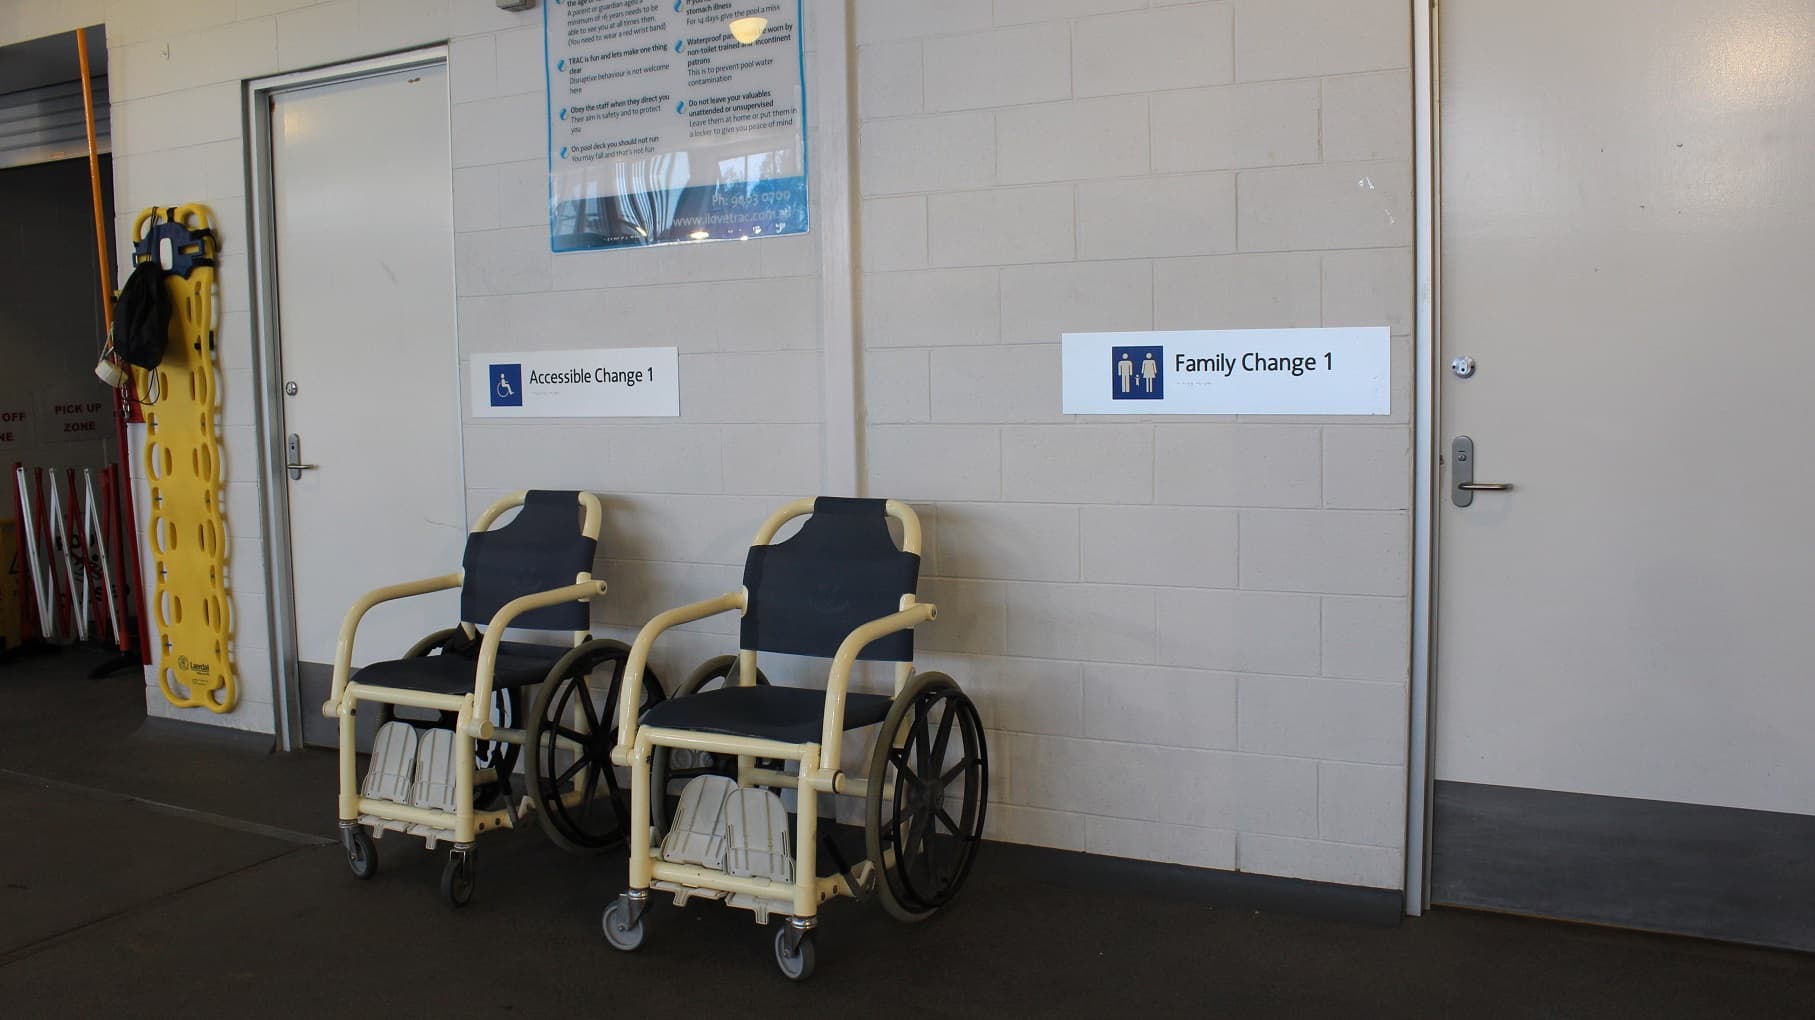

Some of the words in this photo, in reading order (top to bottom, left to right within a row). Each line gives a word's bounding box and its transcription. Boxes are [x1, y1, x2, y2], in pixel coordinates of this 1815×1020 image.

[568, 17, 594, 26] minimum
[609, 10, 624, 20] years
[624, 8, 642, 16] needs
[573, 6, 590, 17] parent
[598, 2, 624, 12] guardian
[686, 6, 712, 16] stomach
[713, 2, 732, 10] illness
[704, 14, 719, 24] days
[720, 12, 734, 22] give
[745, 8, 760, 16] pool
[765, 4, 780, 12] miss
[568, 28, 580, 36] able
[598, 24, 610, 33] you
[624, 18, 640, 26] times
[580, 34, 594, 44] need
[603, 31, 617, 40] wear
[622, 28, 632, 36] red
[634, 26, 650, 34] wrist
[686, 33, 722, 46] Waterproof
[768, 24, 784, 34] worn
[784, 22, 792, 32] by
[568, 56, 584, 65] TRAC
[584, 55, 590, 63] is
[590, 53, 600, 62] fun
[600, 51, 611, 60] and
[612, 50, 622, 58] lets
[624, 47, 639, 56] make
[640, 45, 652, 53] one
[652, 42, 668, 53] thing
[687, 45, 717, 56] non-toilet
[718, 41, 740, 52] trained
[754, 34, 792, 46] incontinent
[569, 66, 582, 76] clear
[688, 57, 710, 68] patrons
[688, 68, 700, 77] This
[715, 63, 739, 74] prevent
[740, 60, 754, 71] pool
[755, 58, 774, 67] water
[570, 74, 598, 85] Disruptive
[598, 70, 625, 81] behaviour
[632, 66, 642, 75] not
[643, 63, 670, 73] welcome
[688, 74, 732, 87] contamination
[570, 86, 582, 95] here
[688, 98, 698, 107] Do
[698, 98, 710, 106] not
[710, 95, 726, 104] leave
[727, 94, 740, 104] your
[742, 89, 772, 100] valuables
[570, 104, 584, 114] Obey
[585, 102, 595, 112] the
[596, 101, 610, 110] staff
[610, 98, 628, 108] when
[628, 96, 640, 107] they
[640, 95, 657, 105] direct
[658, 94, 670, 104] you
[688, 106, 724, 118] unattended
[732, 100, 774, 112] unsupervised
[570, 116, 584, 124] Their
[585, 112, 596, 121] aim
[602, 108, 620, 120] safety
[620, 108, 632, 116] and
[632, 107, 639, 115] to
[640, 104, 661, 116] protect
[689, 118, 706, 128] Leave
[707, 116, 725, 126] them
[726, 116, 732, 124] at
[733, 113, 751, 122] home
[760, 110, 772, 121] put
[772, 108, 789, 117] them
[790, 106, 798, 114] in
[570, 126, 582, 136] you
[694, 127, 712, 137] locker
[721, 126, 735, 136] give
[736, 124, 748, 134] you
[748, 122, 768, 132] peace
[768, 120, 775, 128] of
[776, 118, 792, 128] mind
[571, 144, 580, 153] On
[580, 142, 593, 154] pool
[593, 141, 606, 150] deck
[606, 140, 618, 151] you
[618, 138, 637, 148] should
[638, 136, 648, 146] not
[649, 135, 660, 143] run
[571, 154, 582, 163] You
[582, 153, 594, 163] may
[595, 150, 604, 160] fall
[604, 149, 616, 158] and
[616, 147, 632, 158] that's
[634, 146, 644, 155] not
[644, 144, 654, 154] fun
[712, 194, 729, 208] Ph:
[1175, 353, 1236, 377] Family
[1242, 352, 1316, 376] Change
[1324, 352, 1333, 371] 1
[529, 368, 592, 385] Accessible
[594, 368, 643, 386] Change
[647, 367, 654, 382] 1
[2, 412, 26, 422] OFF
[54, 404, 82, 415] PICK
[86, 402, 102, 413] UP
[64, 421, 96, 433] ZONE
